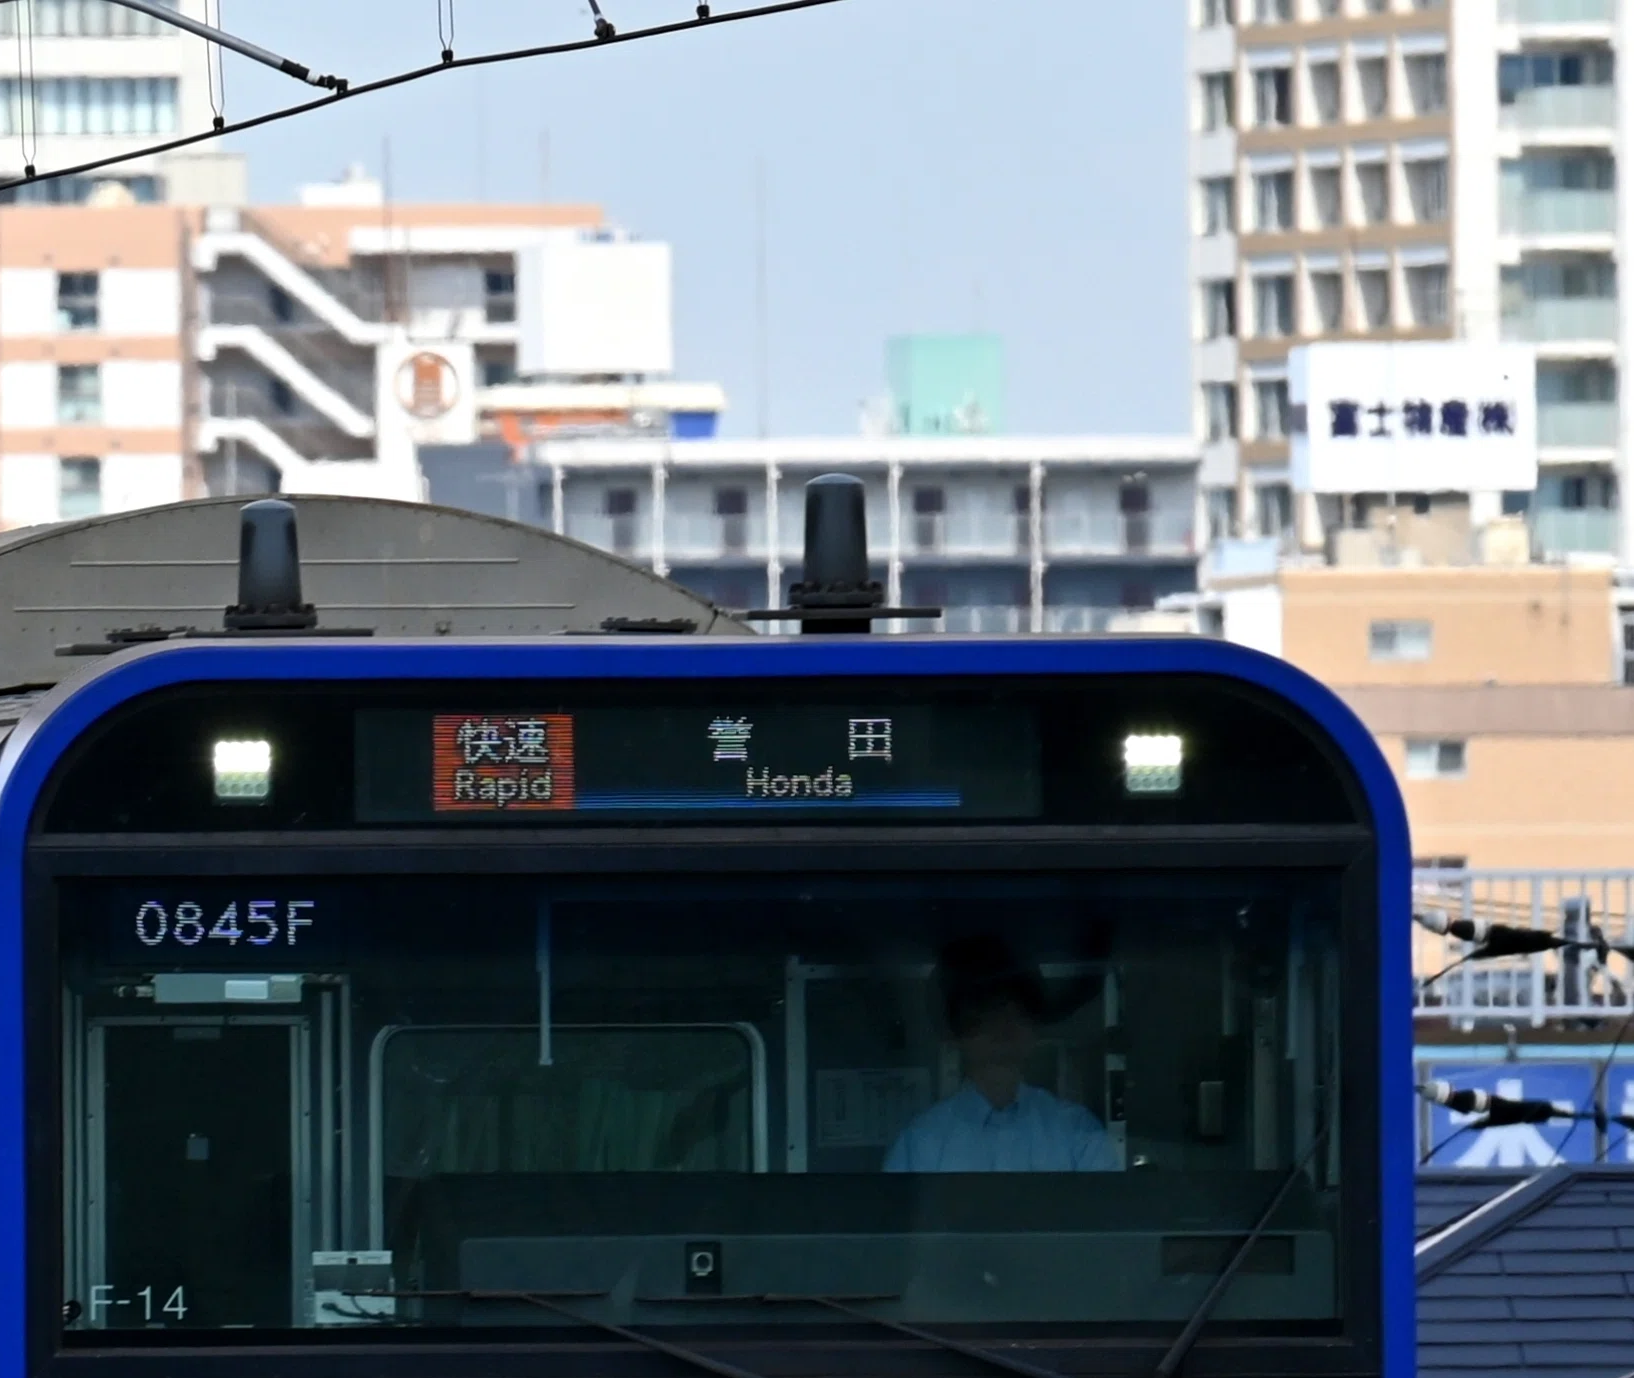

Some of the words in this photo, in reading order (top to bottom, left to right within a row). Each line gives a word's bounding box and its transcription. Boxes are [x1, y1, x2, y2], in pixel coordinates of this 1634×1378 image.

[456, 718, 550, 764] 快速
[454, 768, 552, 807] Rapid
[746, 766, 853, 797] Honda
[135, 901, 315, 945] 0845F
[89, 1284, 189, 1321] F-14
